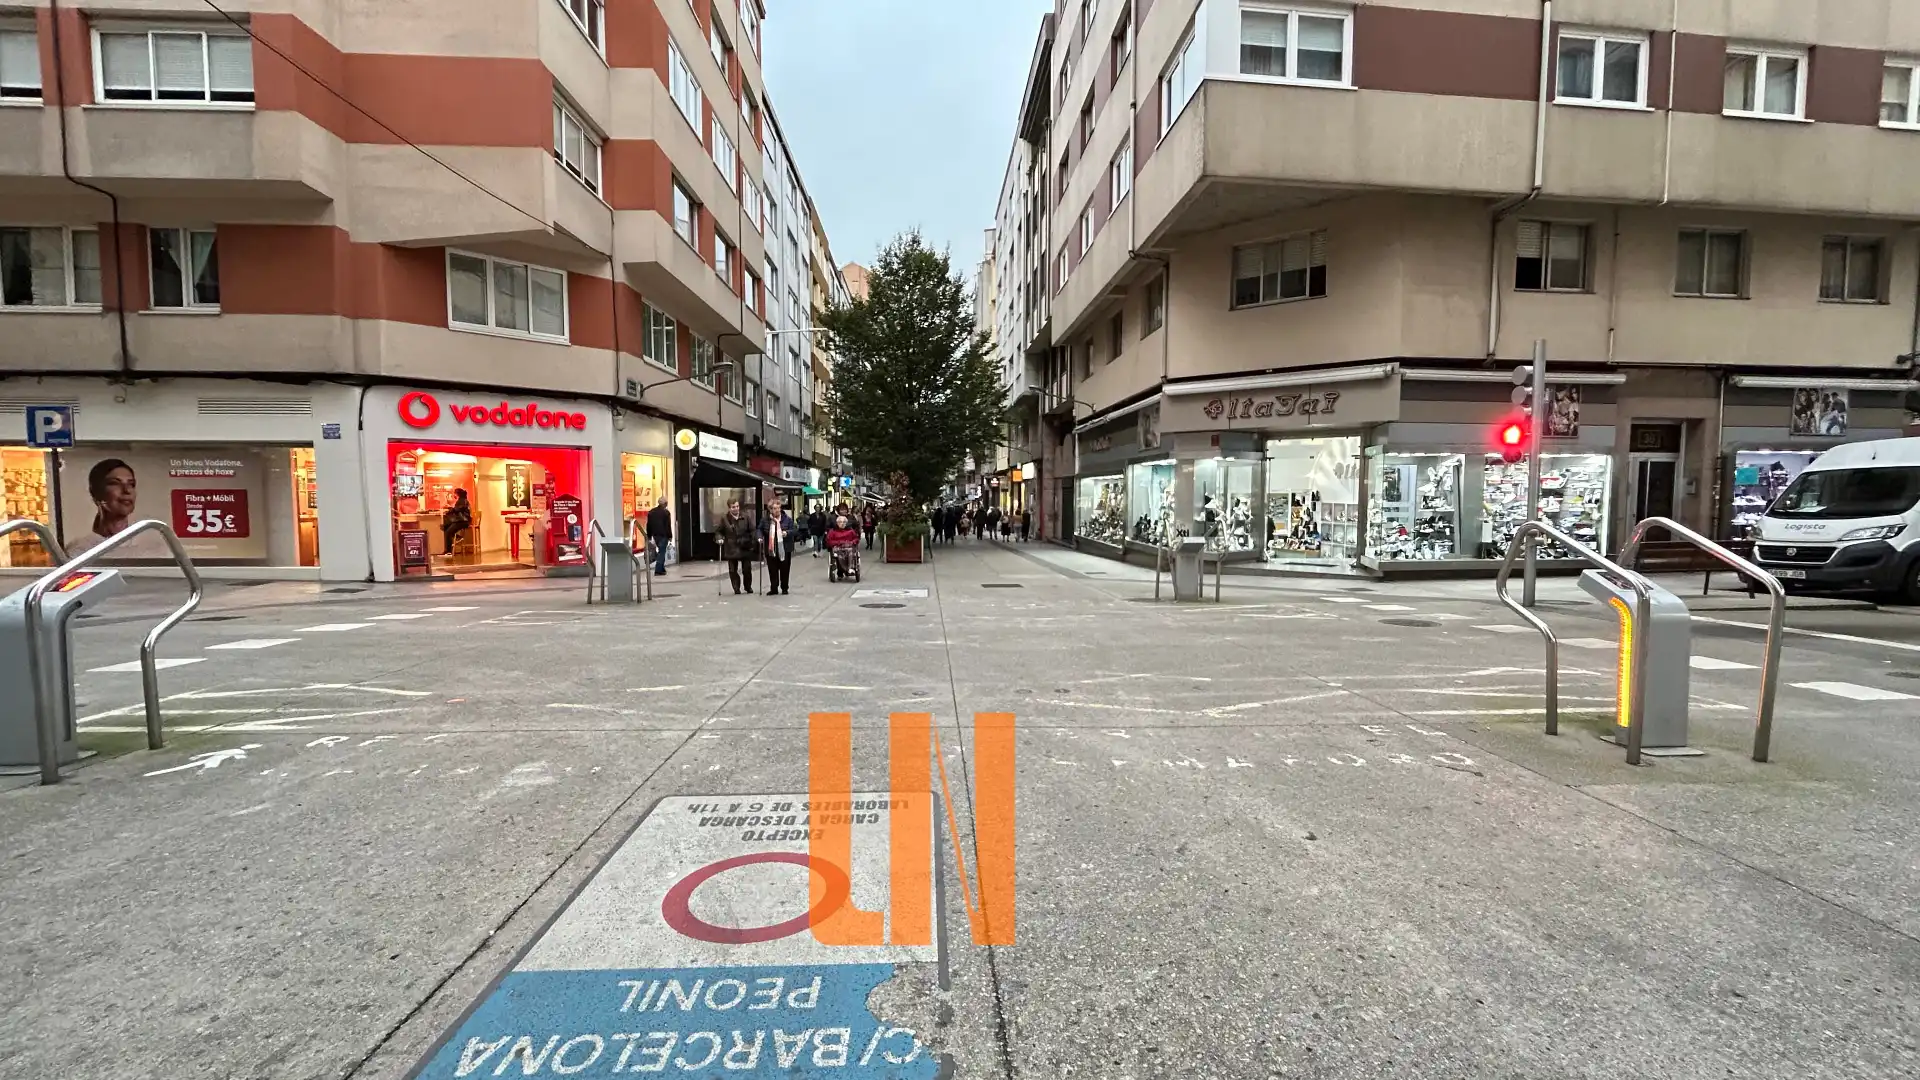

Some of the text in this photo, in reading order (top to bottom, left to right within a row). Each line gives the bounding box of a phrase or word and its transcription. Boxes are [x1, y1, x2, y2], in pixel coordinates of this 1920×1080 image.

[449, 400, 587, 430] vodafone
[34, 410, 63, 443] P
[215, 468, 234, 476] hoxe
[185, 494, 205, 502] Fibra
[212, 494, 235, 502] Móbil
[1785, 523, 1826, 531] Logista
[687, 803, 721, 814] 11h
[728, 803, 742, 813] A
[750, 802, 764, 812] 6
[770, 801, 793, 812] DE
[698, 812, 880, 828] CARGA Y DESCARGA
[741, 829, 825, 842] EXCEPTO
[618, 975, 823, 1013] PEONIL
